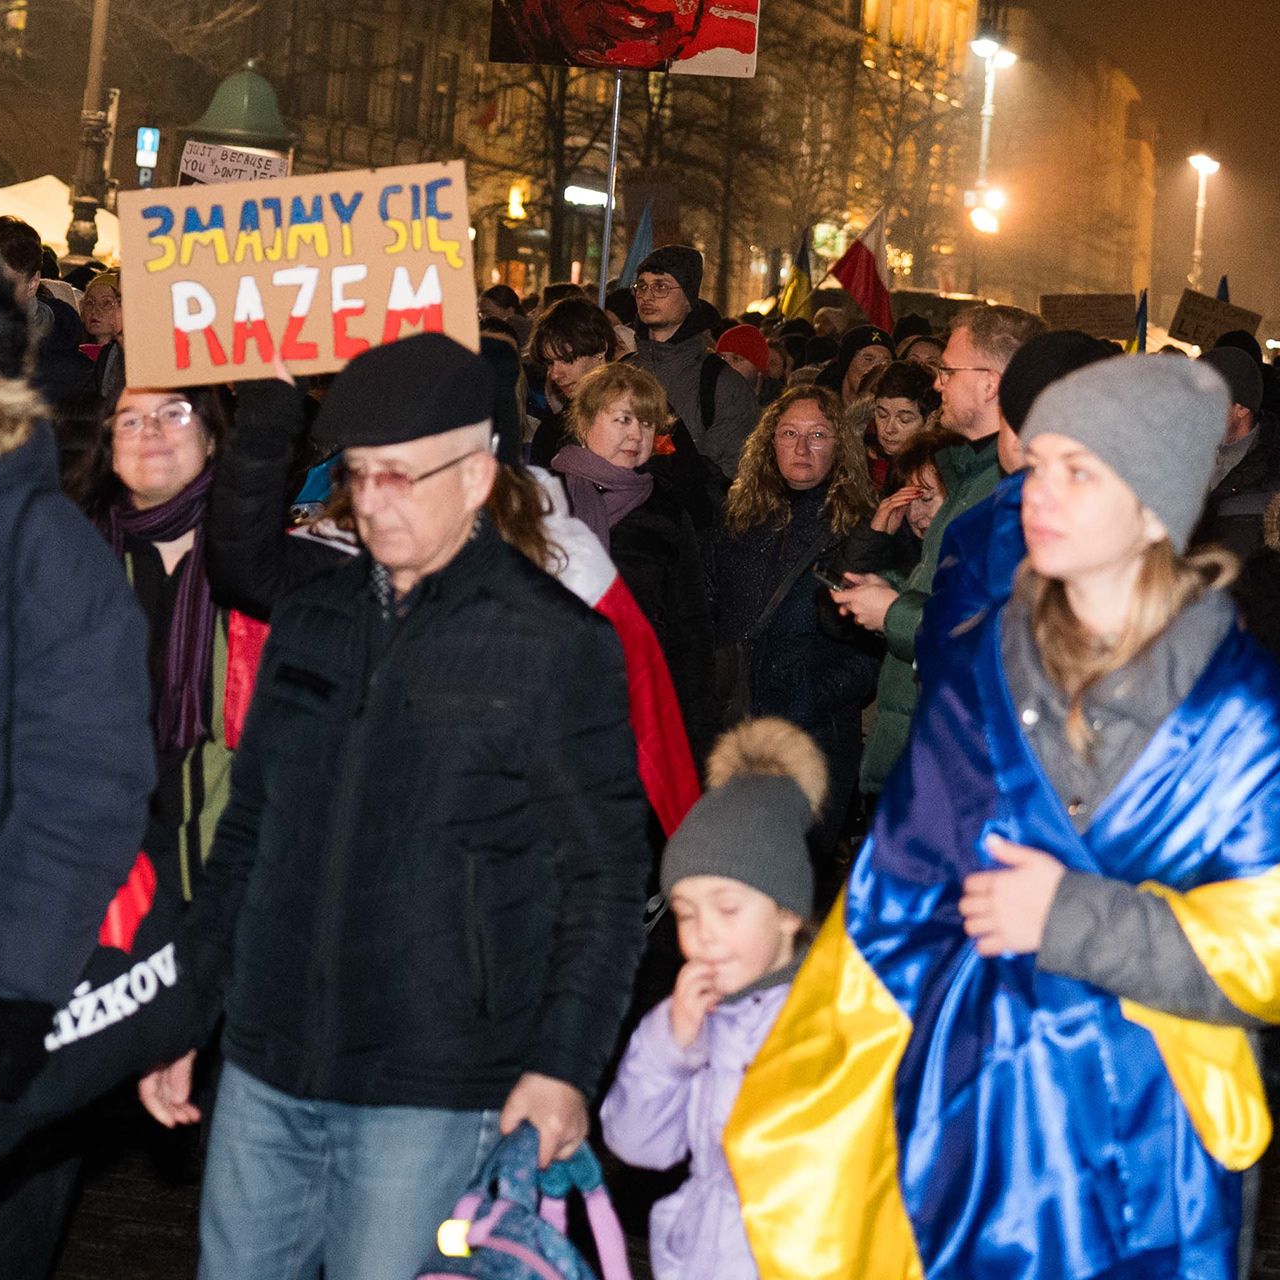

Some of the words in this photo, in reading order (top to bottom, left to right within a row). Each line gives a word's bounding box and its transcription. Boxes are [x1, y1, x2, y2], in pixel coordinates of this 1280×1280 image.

[184, 158, 206, 174] YOU
[213, 164, 248, 181] DON'T
[185, 142, 214, 157] JUST
[220, 148, 273, 170] BECAUSE
[378, 177, 464, 269] SIĘ
[171, 264, 444, 370] RAZEM
